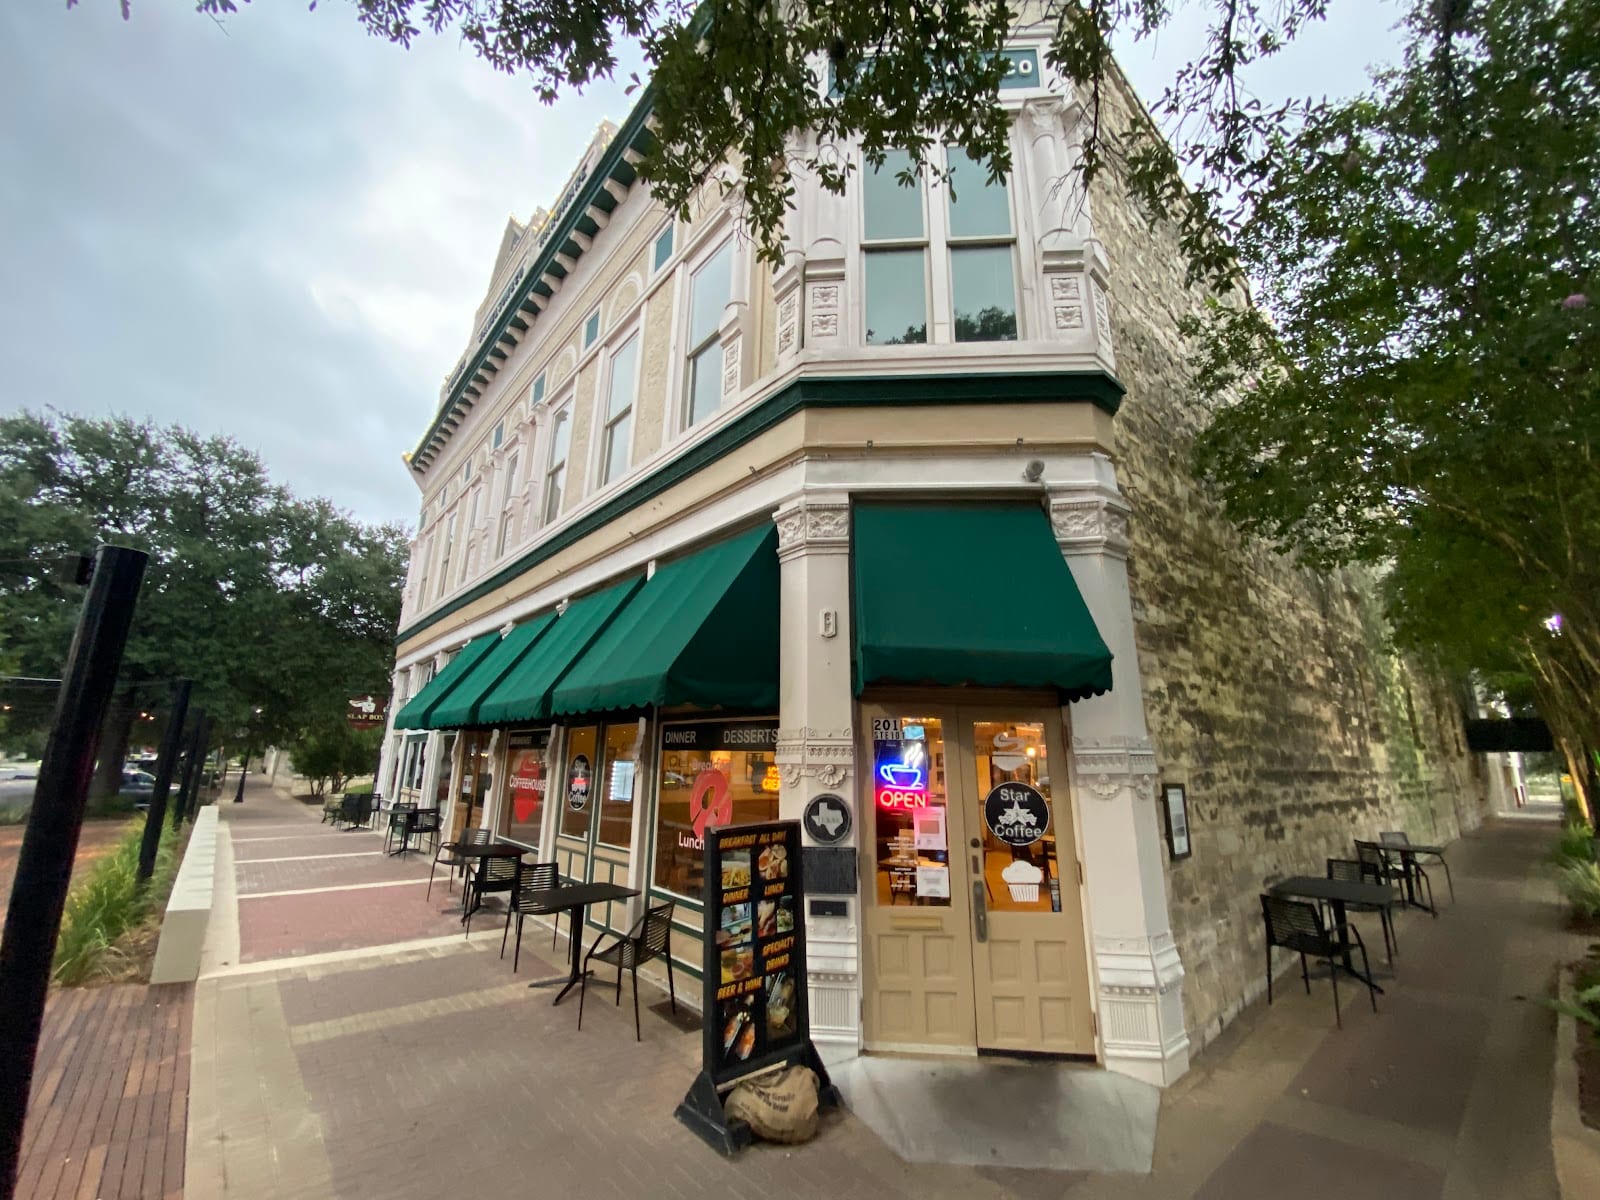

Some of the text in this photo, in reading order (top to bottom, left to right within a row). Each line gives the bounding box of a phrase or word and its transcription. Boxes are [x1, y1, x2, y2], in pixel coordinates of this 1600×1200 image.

[874, 719, 898, 731] 201
[665, 728, 778, 744] DINNER DESSERTS
[880, 790, 926, 809] OPEN
[1000, 788, 1030, 801] Star
[995, 824, 1042, 839] Coffee
[678, 831, 705, 851] Lunch
[762, 936, 795, 956] SPECIALTY
[717, 984, 737, 1001] BEER
